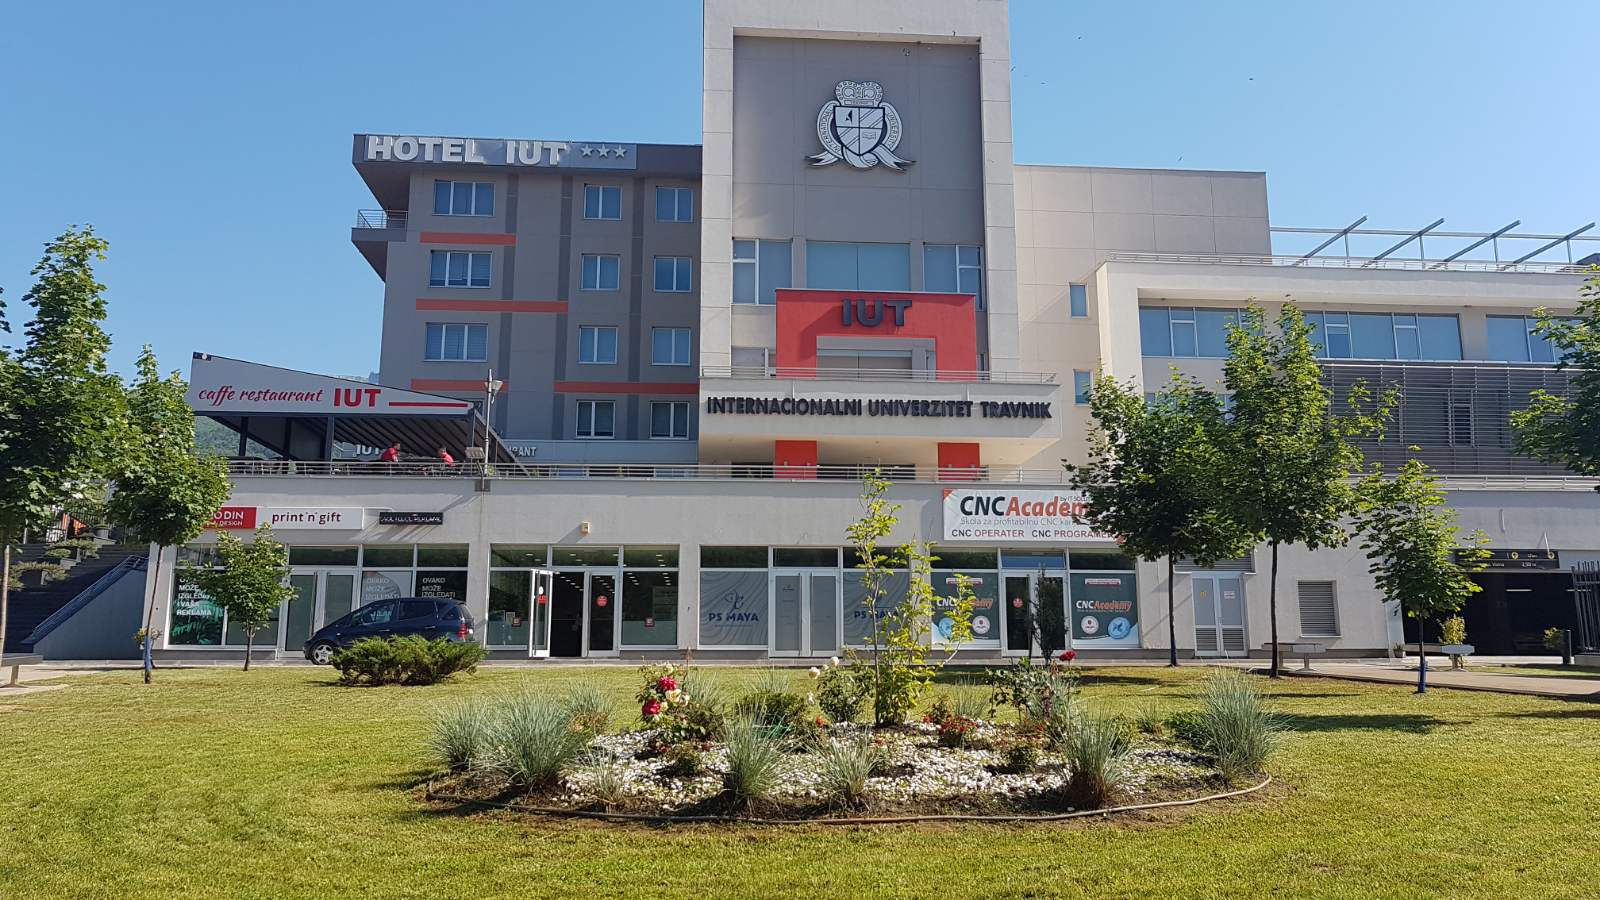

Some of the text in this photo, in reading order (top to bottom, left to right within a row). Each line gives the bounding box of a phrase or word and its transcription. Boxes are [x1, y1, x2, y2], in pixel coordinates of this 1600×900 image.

[367, 135, 567, 166] HOTEL IUT
[842, 299, 912, 327] IUT
[198, 385, 381, 407] caffe restaurant IUT
[707, 397, 1053, 419] INTERNACIONALNI UNIVERZITET TRAVNIK
[960, 495, 1090, 517] CNCAcadem
[951, 529, 972, 537] CNC
[974, 529, 1025, 538] OPERATER
[1031, 530, 1052, 538] CNC
[993, 518, 1039, 527] profitabilnu
[1040, 518, 1059, 526] CNC
[708, 612, 760, 622] PS MAYA
